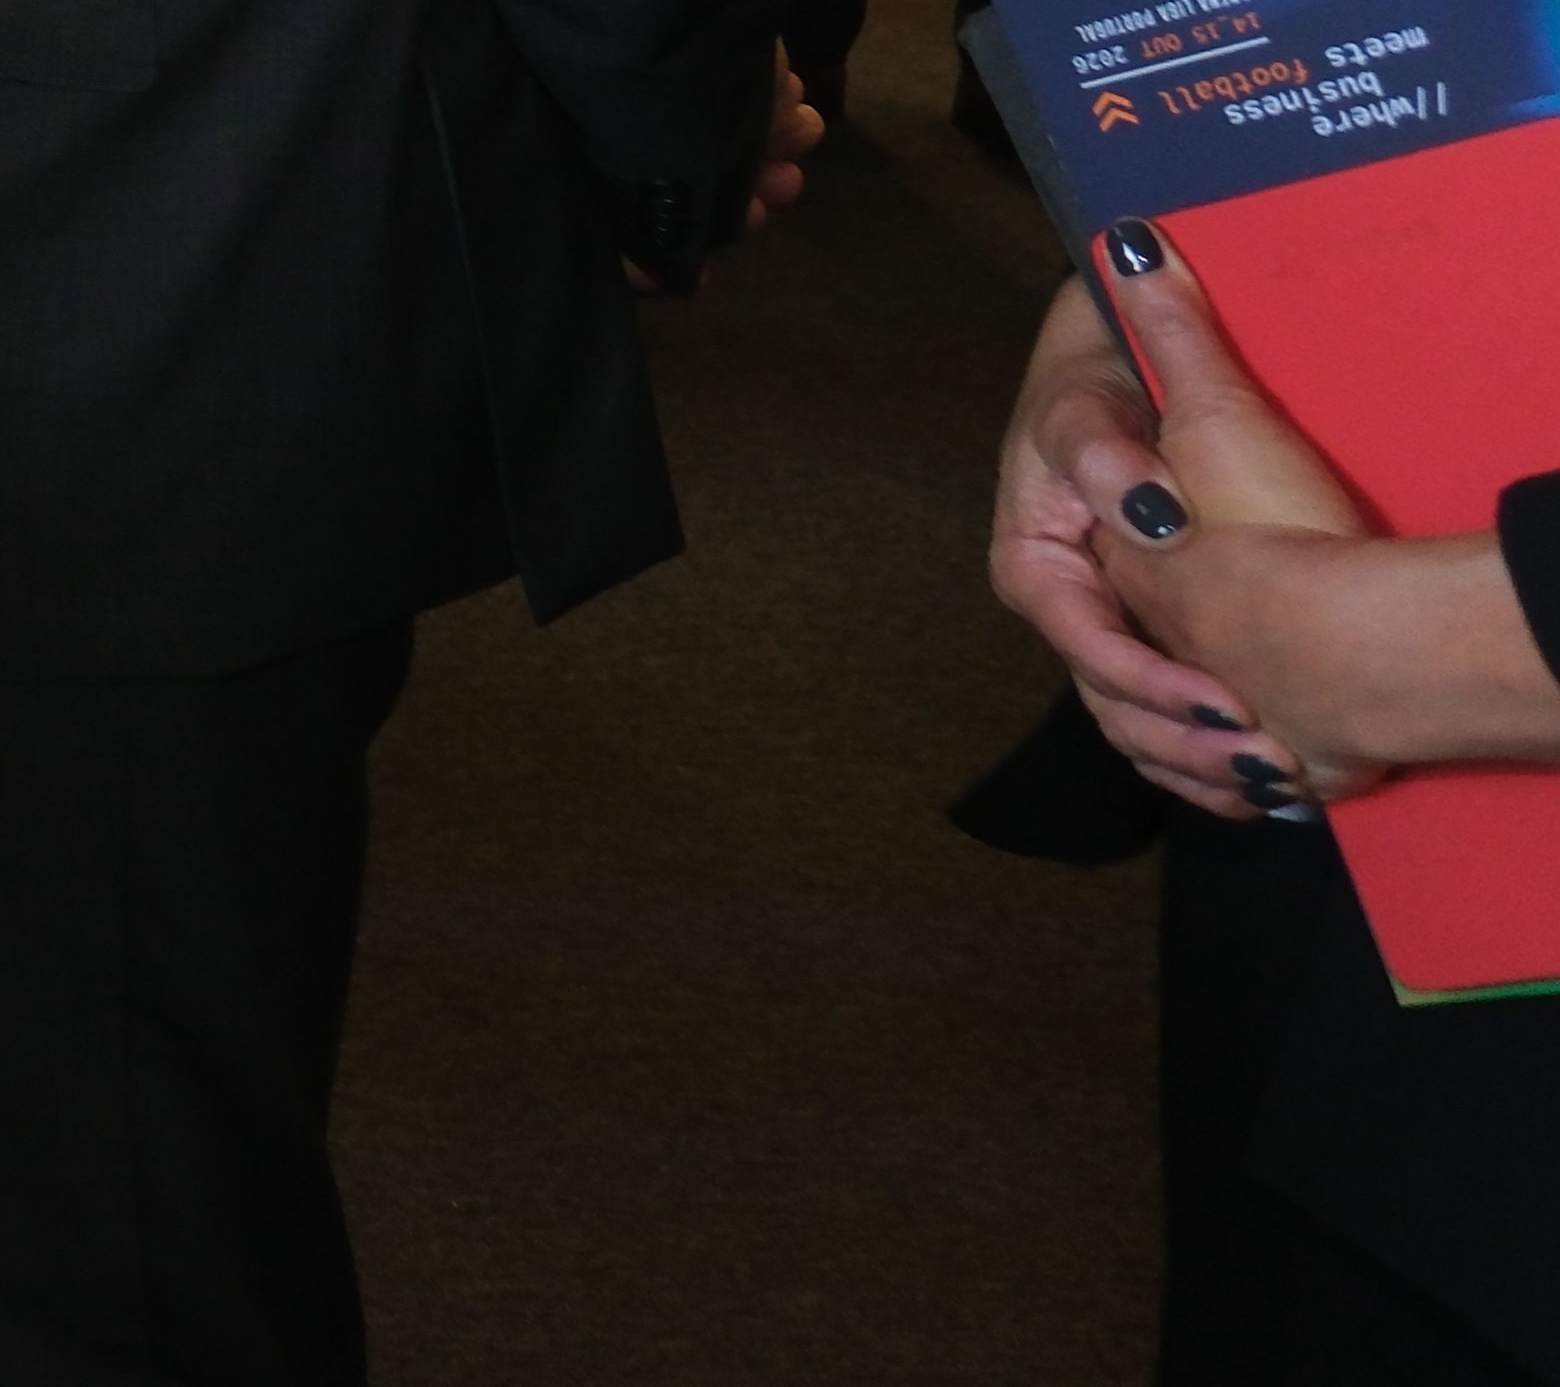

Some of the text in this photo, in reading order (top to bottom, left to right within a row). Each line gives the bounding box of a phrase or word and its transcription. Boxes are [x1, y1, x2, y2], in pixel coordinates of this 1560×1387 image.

[1074, 7, 1157, 44] PORTUGAL
[1140, 31, 1183, 60] OUT
[1071, 43, 1130, 75] 2026
[1158, 26, 1430, 116] meets football
[1223, 70, 1384, 126] business
[1311, 81, 1449, 138] //where
